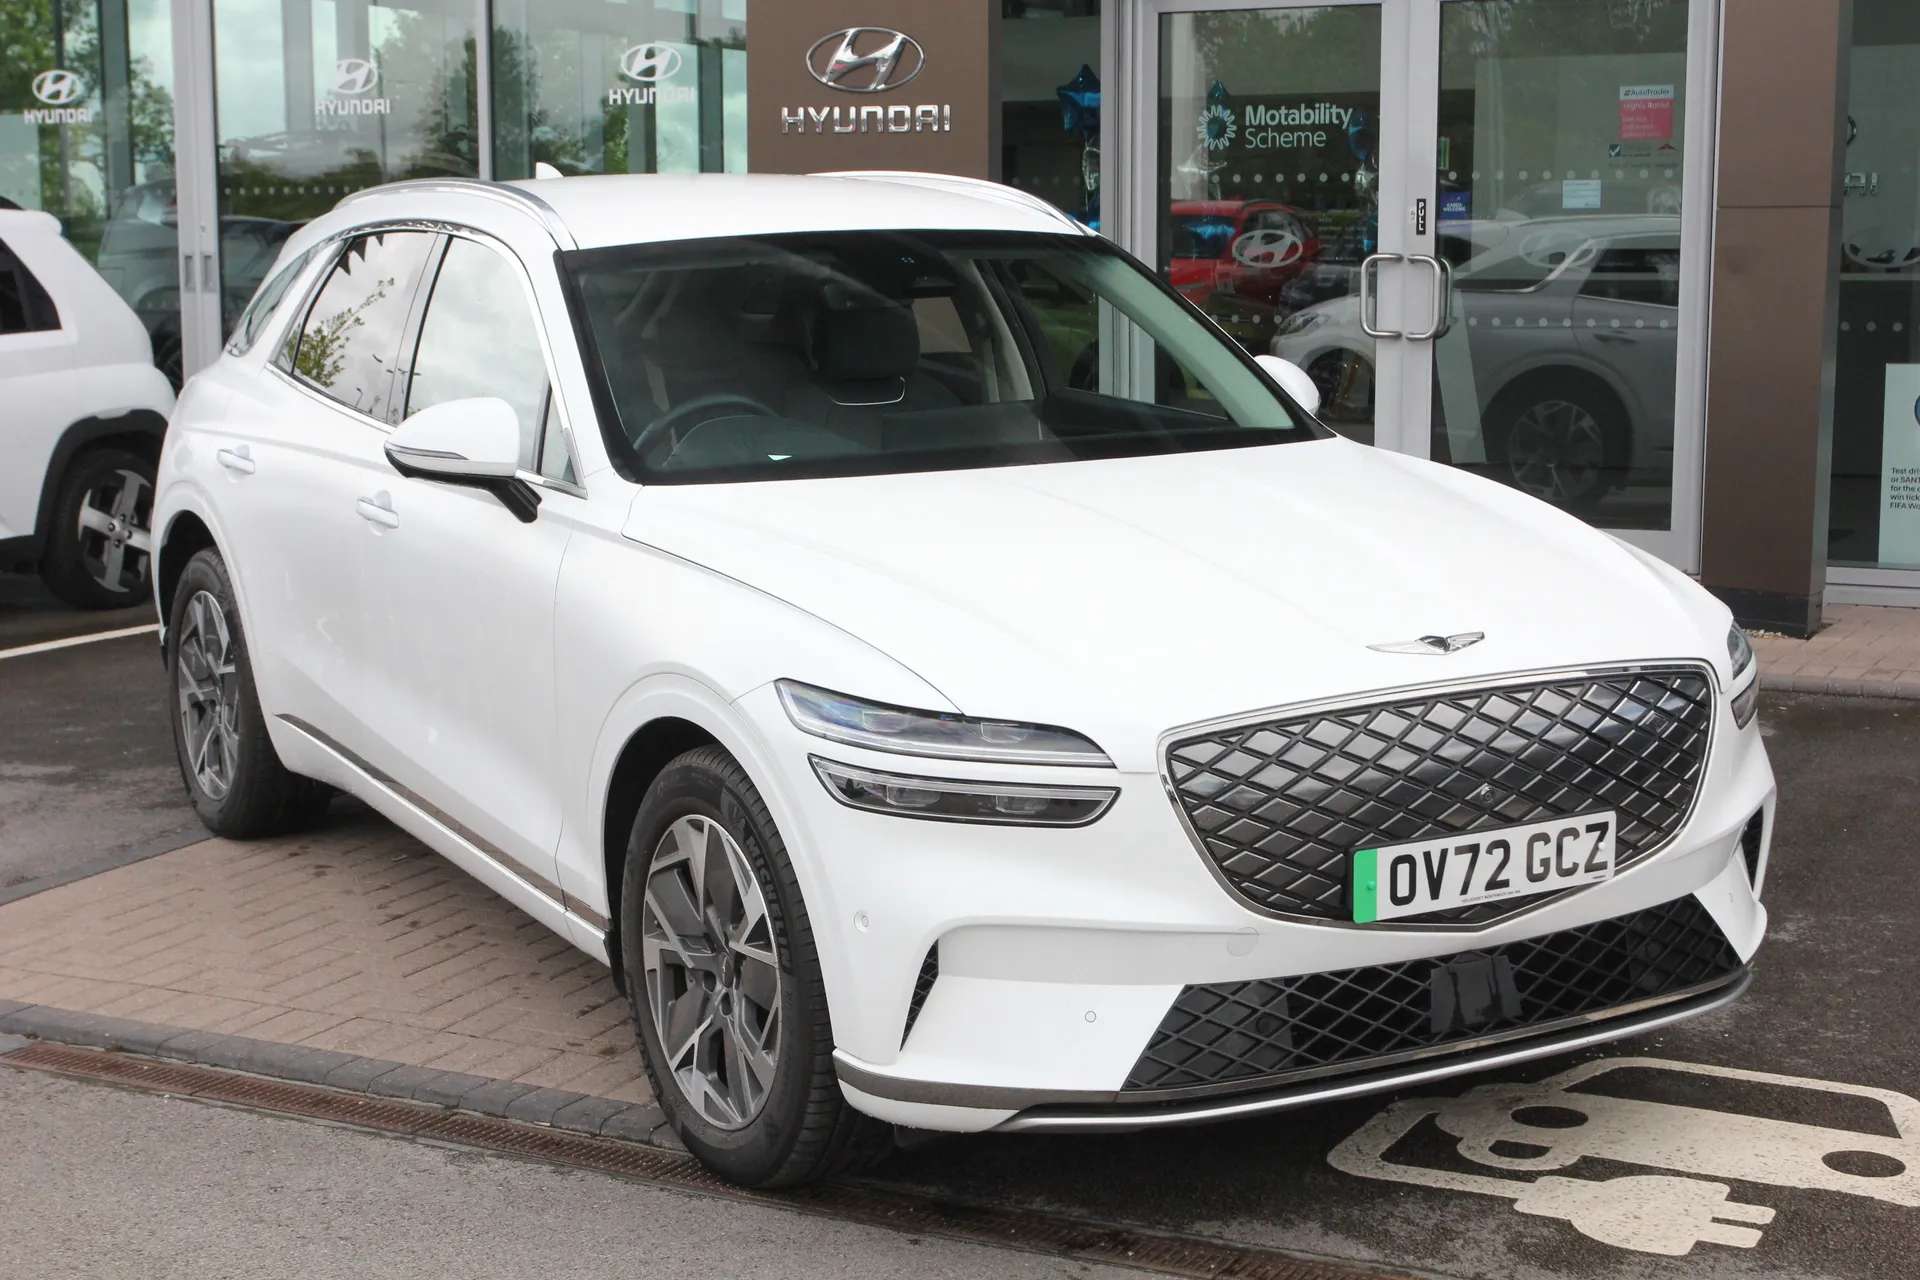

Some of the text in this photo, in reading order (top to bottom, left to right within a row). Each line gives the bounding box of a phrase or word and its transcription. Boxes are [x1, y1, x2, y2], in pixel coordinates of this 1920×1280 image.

[24, 108, 93, 125] HYUNDAI
[315, 98, 390, 116] HYUNDAI
[781, 104, 951, 134] HYUNDAI
[1245, 103, 1353, 129] Motability
[1245, 127, 1327, 149] Scheme
[1390, 821, 1609, 907] OV72 GCZ
[746, 835, 793, 971] MICHELIN
